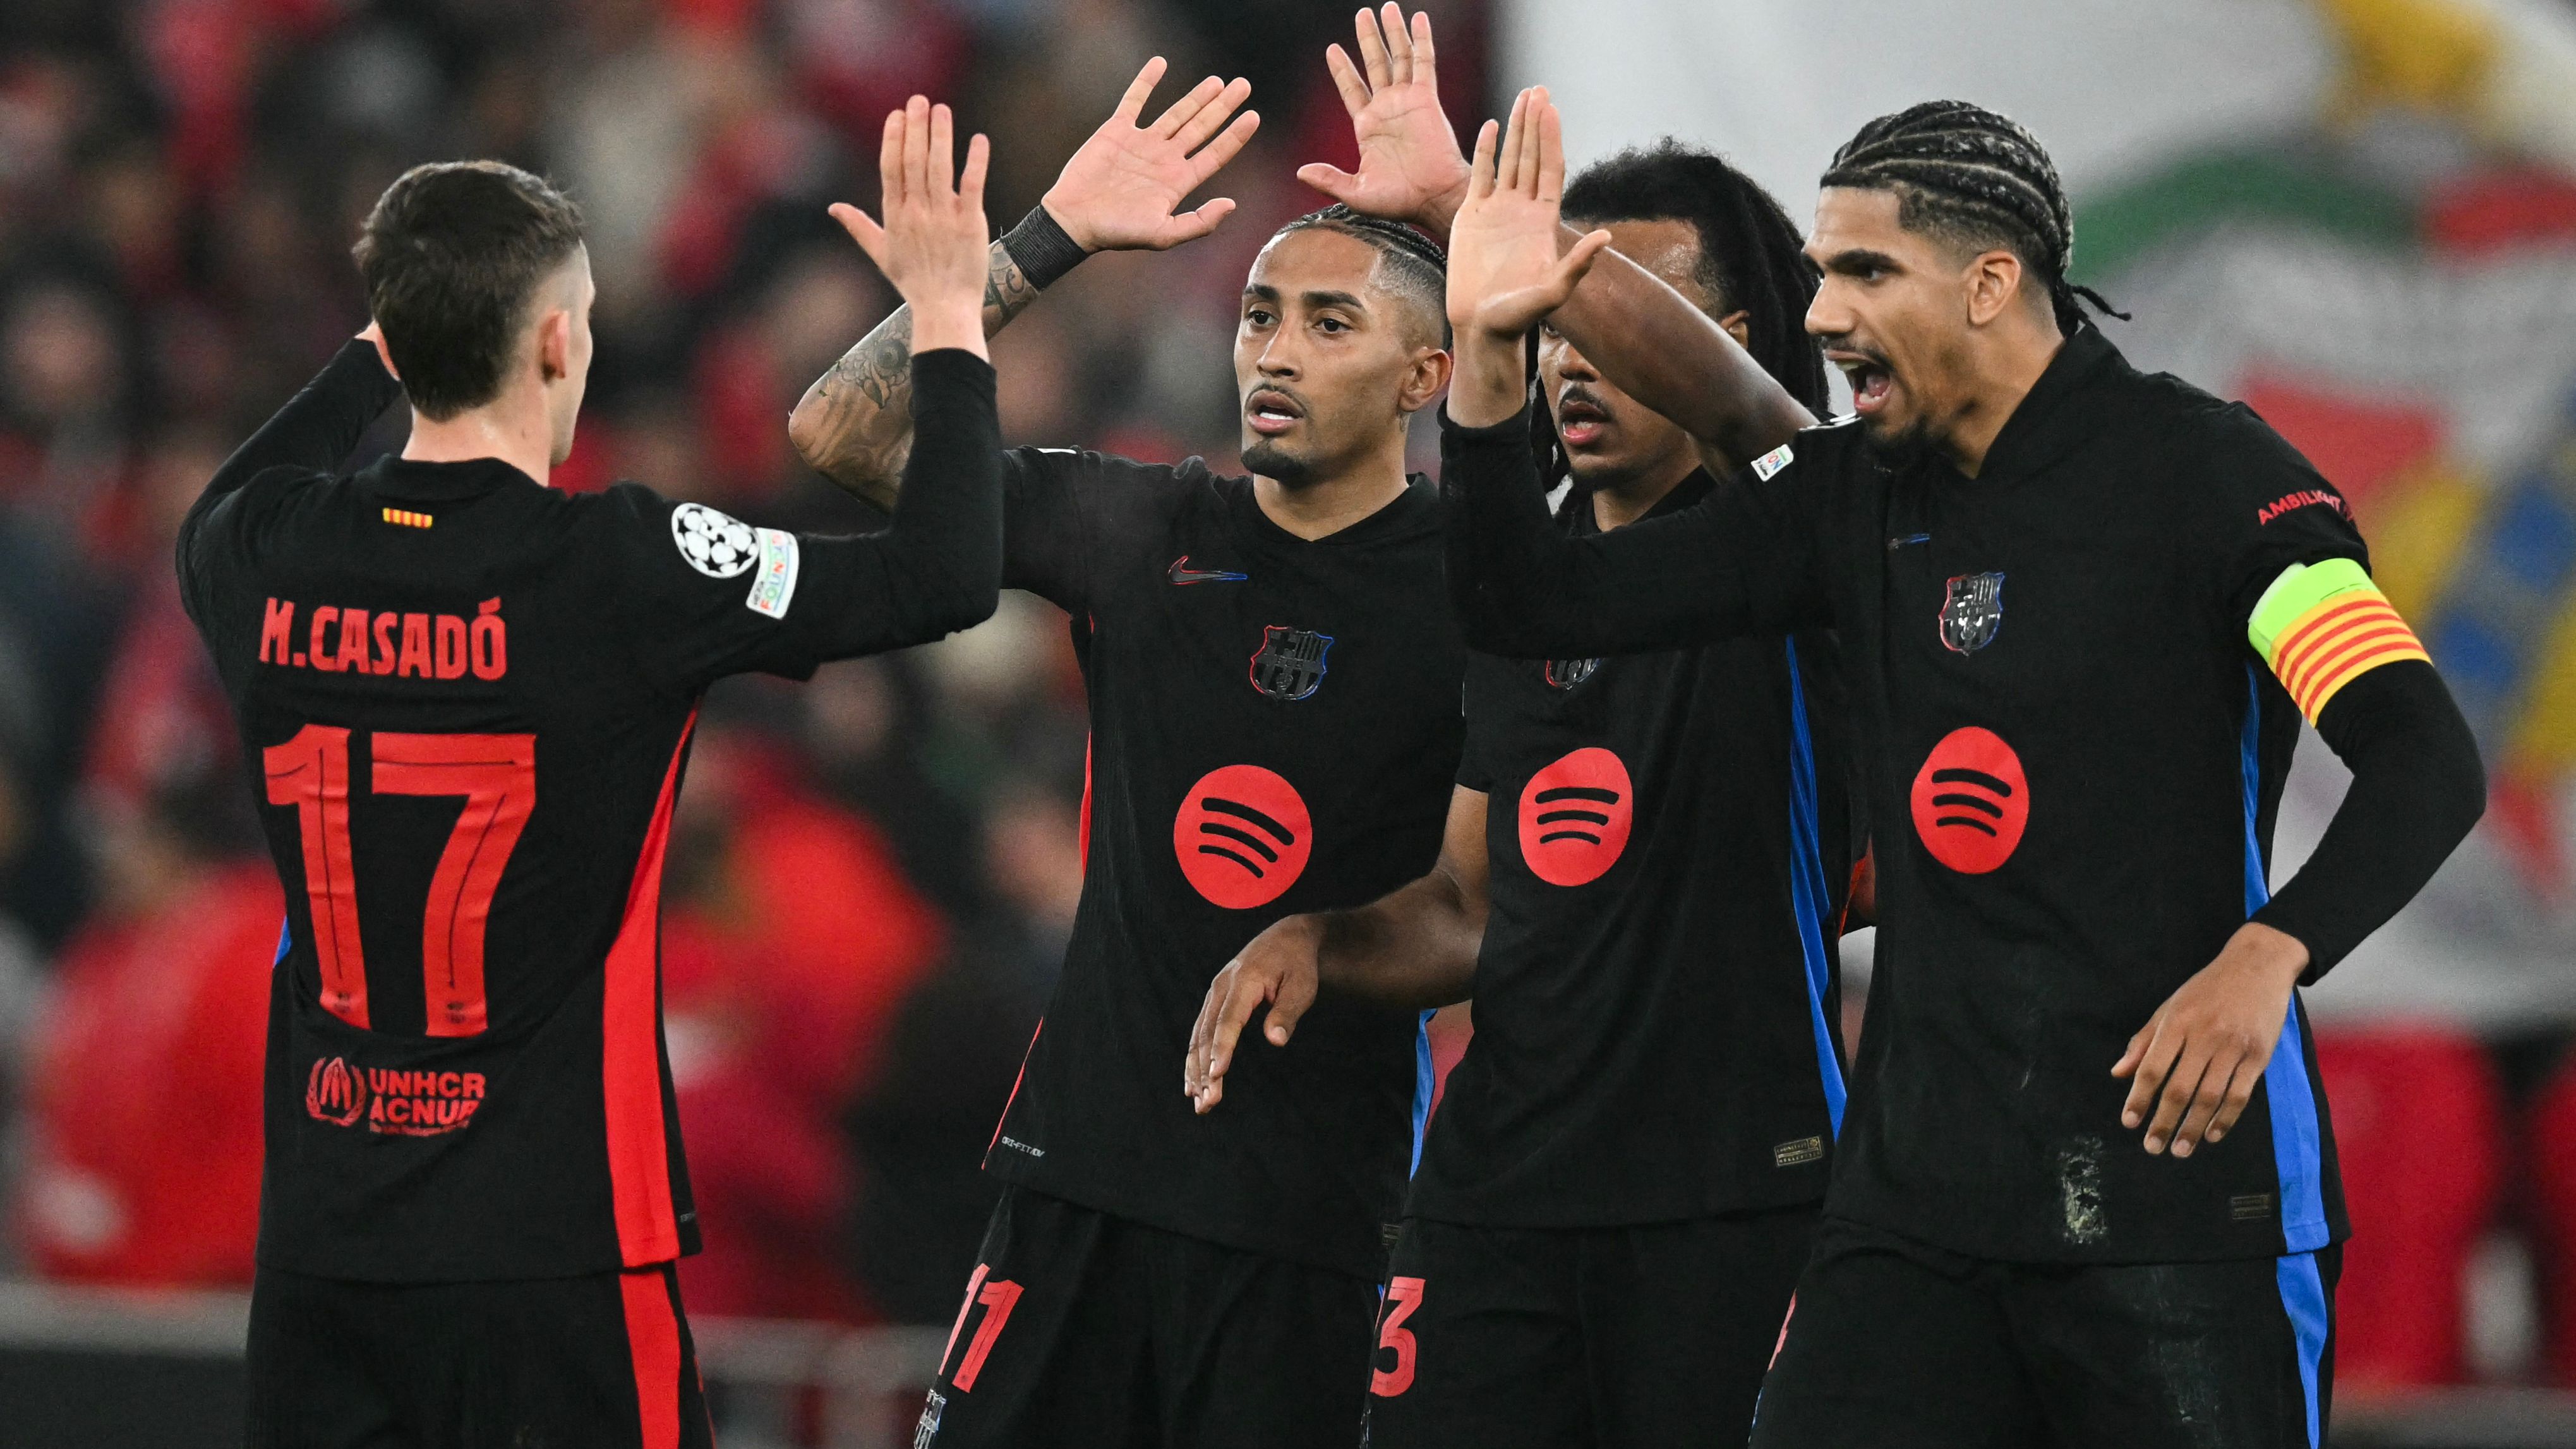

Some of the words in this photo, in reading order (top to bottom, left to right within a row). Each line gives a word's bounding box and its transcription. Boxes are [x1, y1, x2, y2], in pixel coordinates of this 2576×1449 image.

[260, 596, 508, 682] M.CASADÓ
[262, 723, 537, 1038] 17
[369, 1067, 486, 1098] UNHCR
[939, 1263, 1025, 1393] 11
[1369, 1276, 1426, 1397] 3
